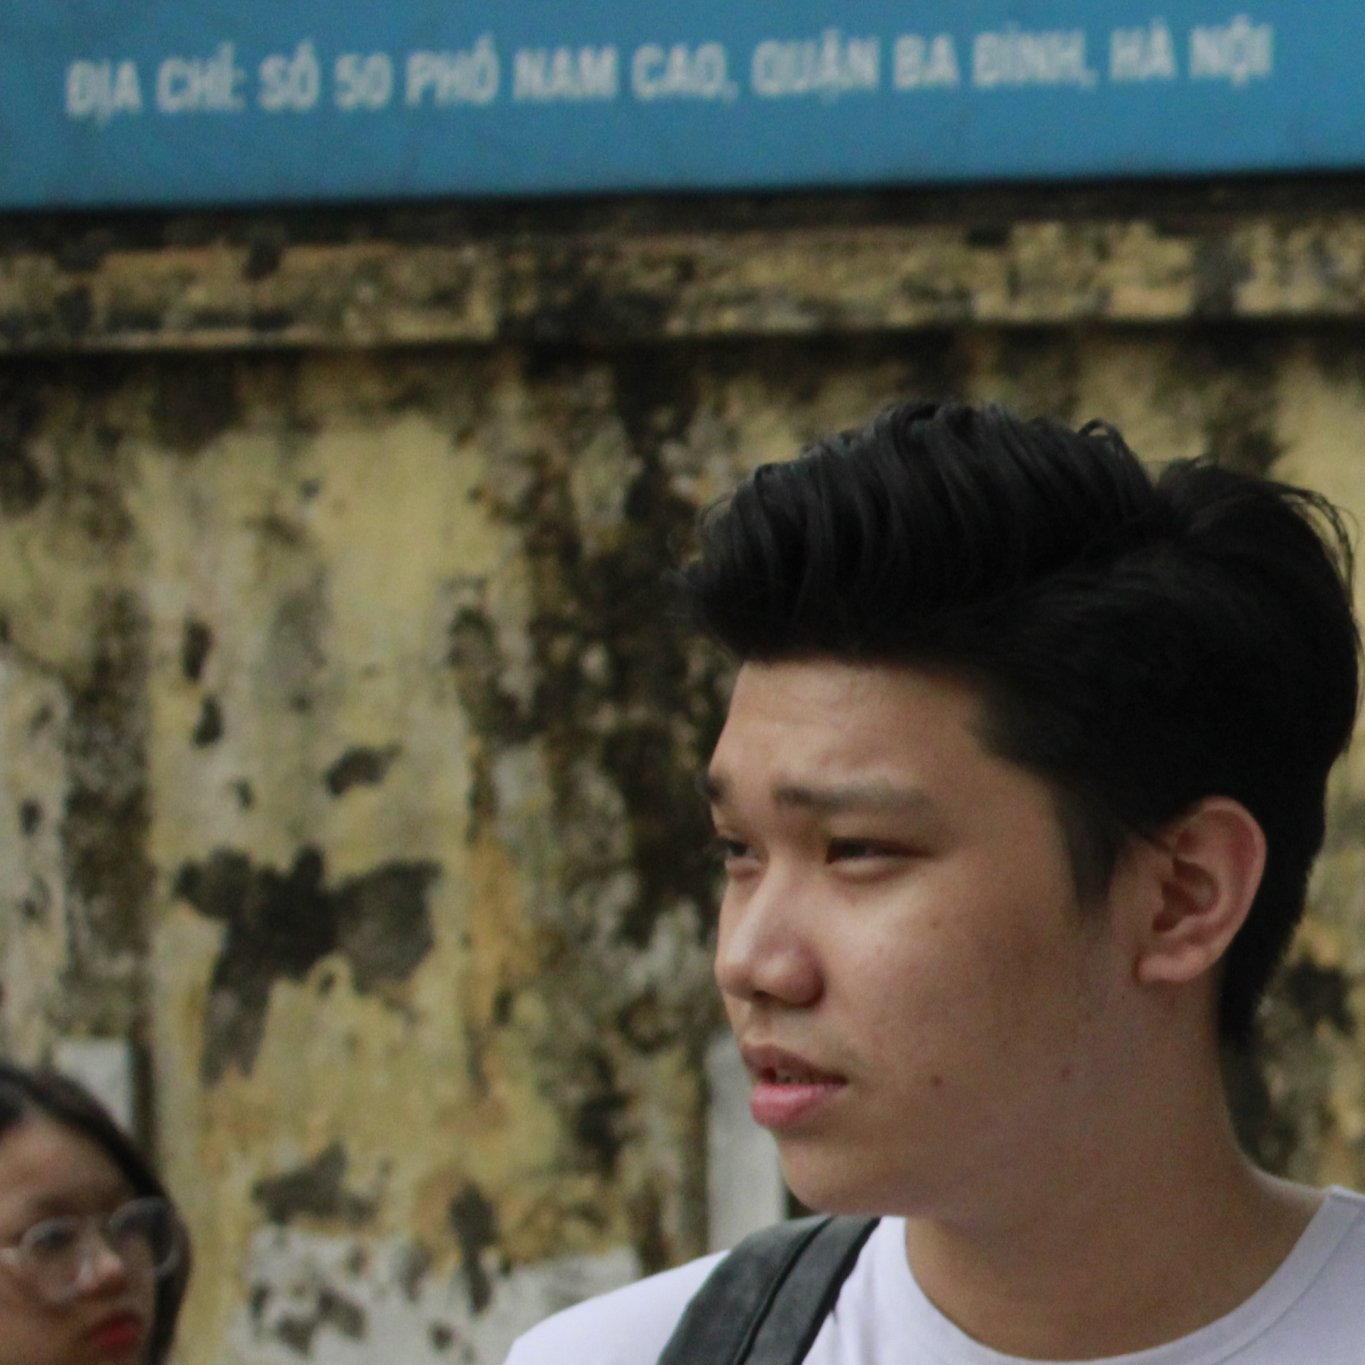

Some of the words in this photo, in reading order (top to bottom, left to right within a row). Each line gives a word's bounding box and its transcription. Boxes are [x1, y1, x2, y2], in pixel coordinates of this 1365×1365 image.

[66, 60, 143, 126] ĐỊA
[258, 40, 320, 111] SỐ
[405, 34, 500, 108] PHỐ
[513, 48, 619, 101] NAM
[632, 43, 738, 105] CAO,
[752, 28, 880, 103] QUẬN
[893, 34, 961, 90] BA
[1189, 14, 1275, 88] NỘI
